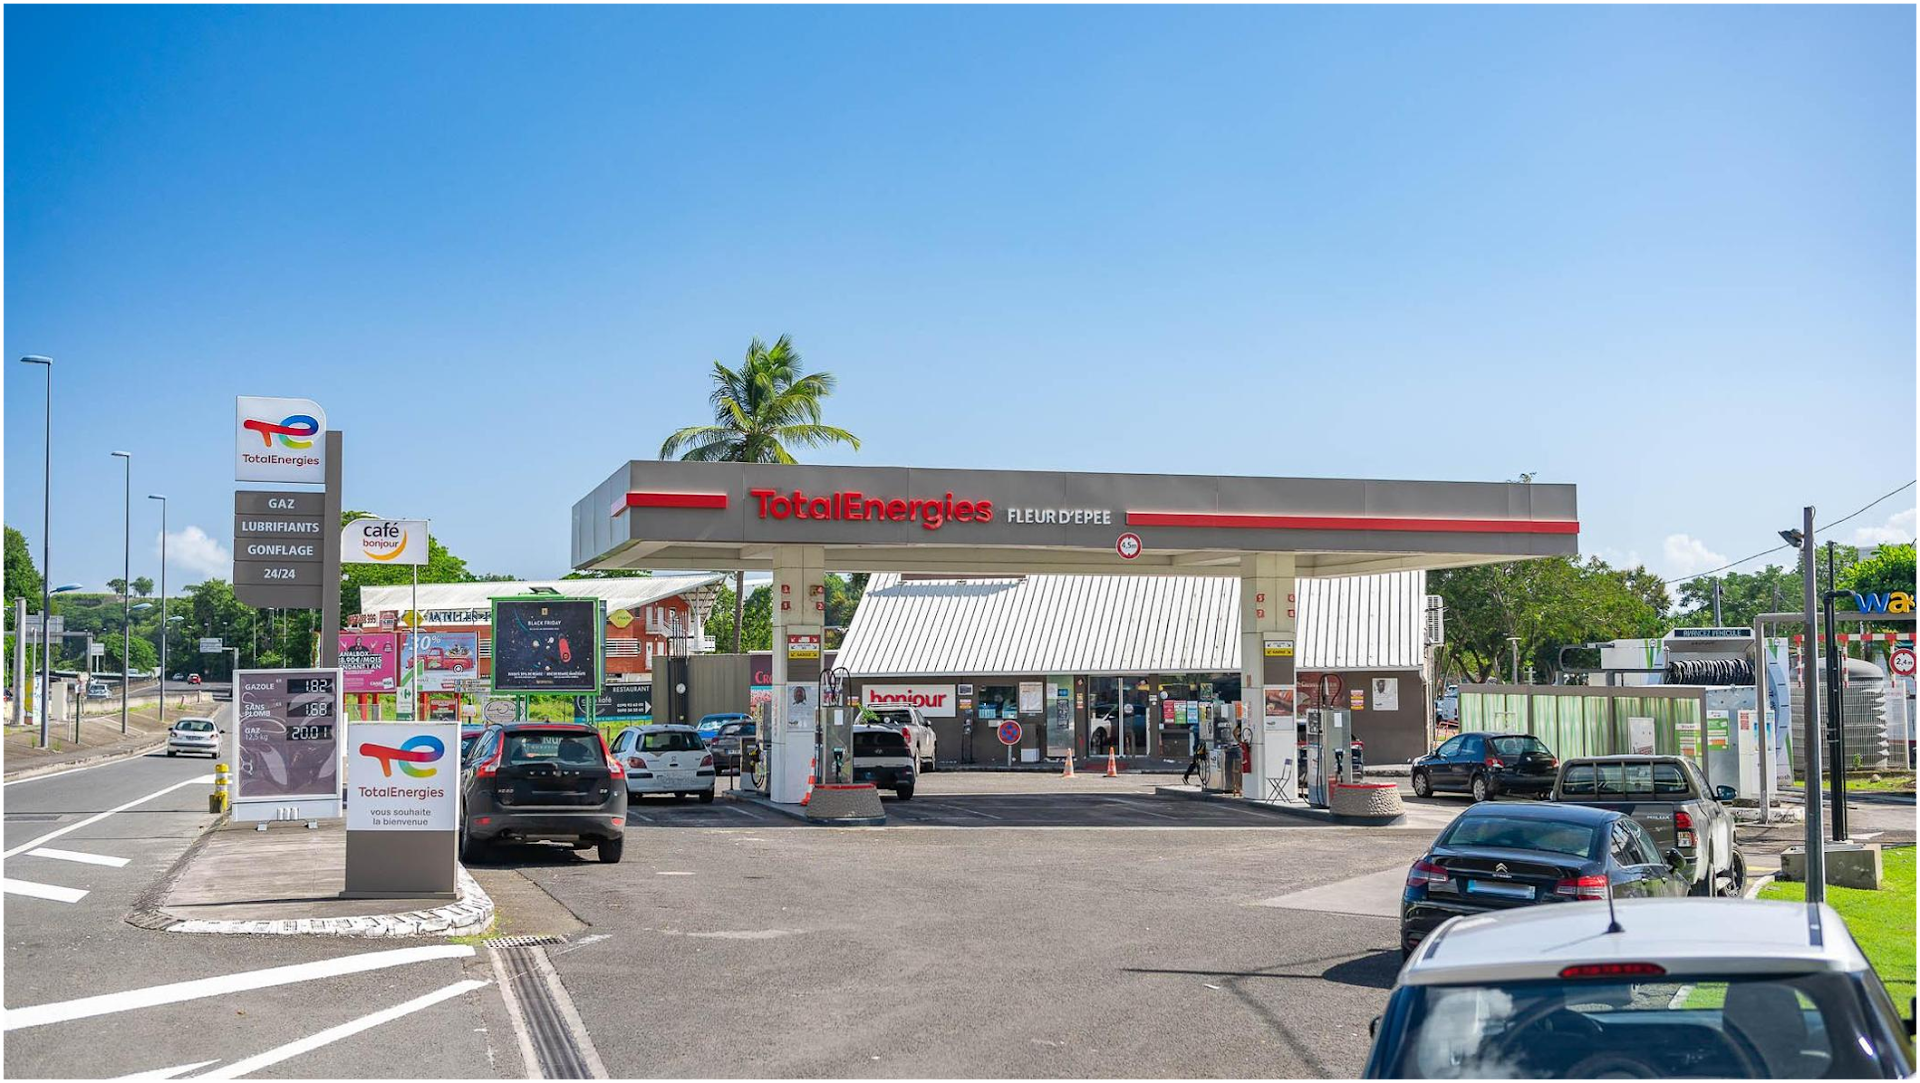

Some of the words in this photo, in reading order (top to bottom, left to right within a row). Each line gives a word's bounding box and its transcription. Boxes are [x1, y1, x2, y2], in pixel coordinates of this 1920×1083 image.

[242, 454, 319, 466] TotalEnergies
[268, 498, 295, 509] GAZ
[750, 488, 993, 530] TotalEnergies
[1007, 508, 1056, 524] FLEUR
[1058, 509, 1112, 525] D'EPEE
[241, 521, 320, 533] LUBRIFIANTS
[363, 522, 399, 538] café
[247, 544, 314, 556] GONFLAGE
[362, 539, 399, 549] bonjour
[263, 568, 296, 579] 24/24
[306, 680, 327, 693] 1.82
[612, 685, 650, 693] RESTAURANT
[306, 702, 327, 716] 1.68
[260, 734, 269, 742] kg
[291, 726, 327, 740] 20.01
[358, 786, 444, 800] TotalEnergies
[370, 809, 392, 817] vous
[392, 808, 431, 817] souhaite
[372, 817, 381, 826] la
[382, 817, 429, 826] bienvenue
